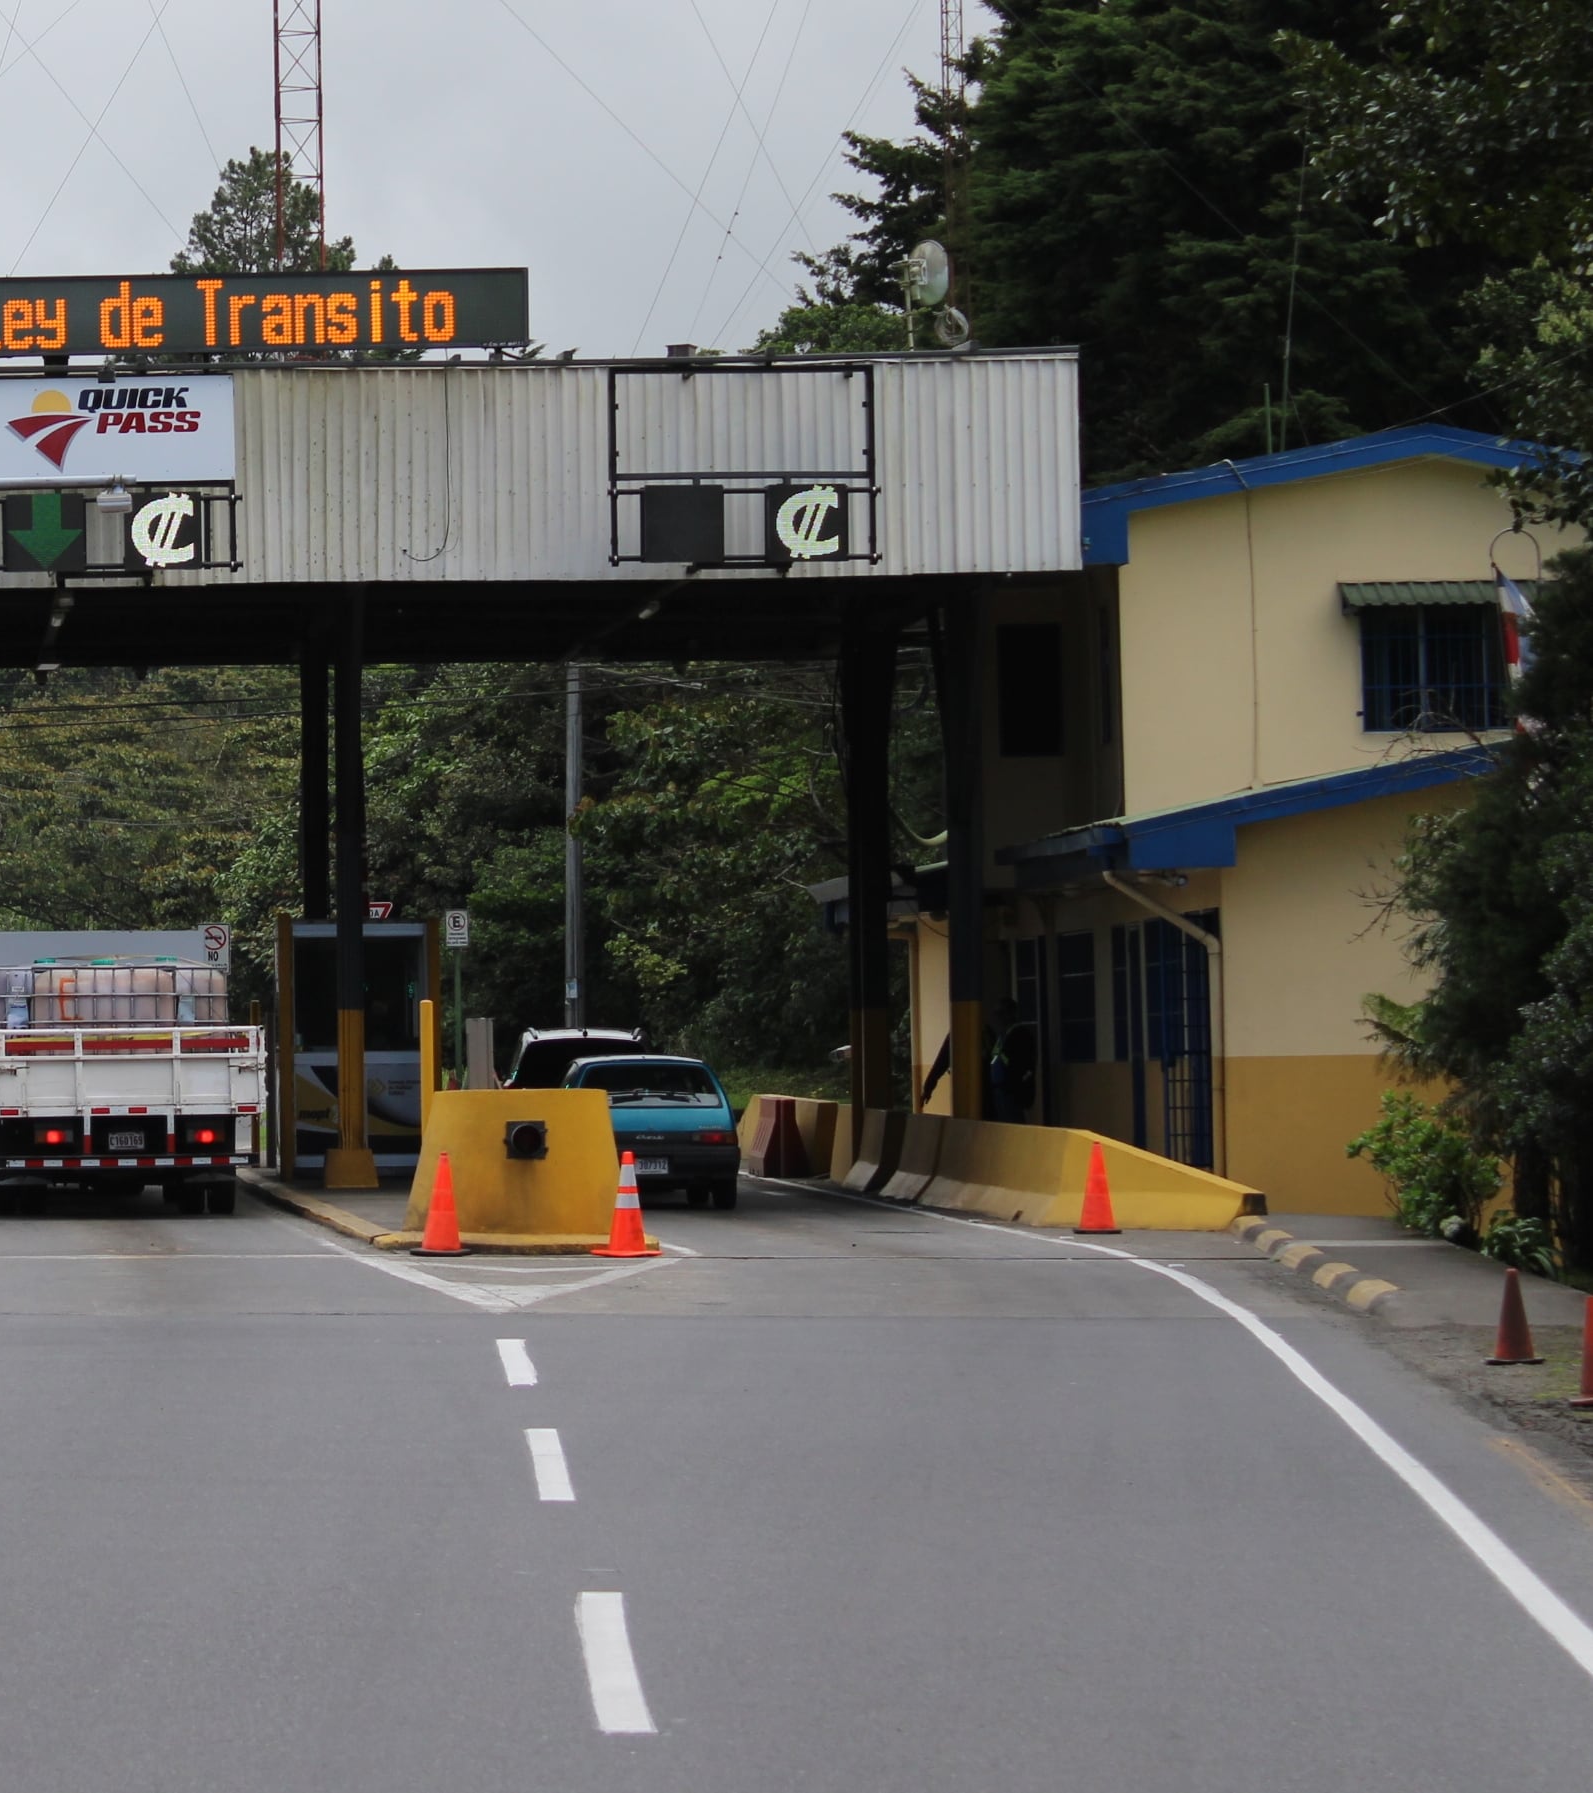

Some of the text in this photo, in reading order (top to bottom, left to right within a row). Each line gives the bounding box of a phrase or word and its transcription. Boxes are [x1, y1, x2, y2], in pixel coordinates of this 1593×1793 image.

[99, 281, 164, 348] de
[196, 279, 455, 346] Transito
[78, 387, 189, 413] QUICK
[96, 411, 201, 434] PASS
[208, 951, 219, 962] NO
